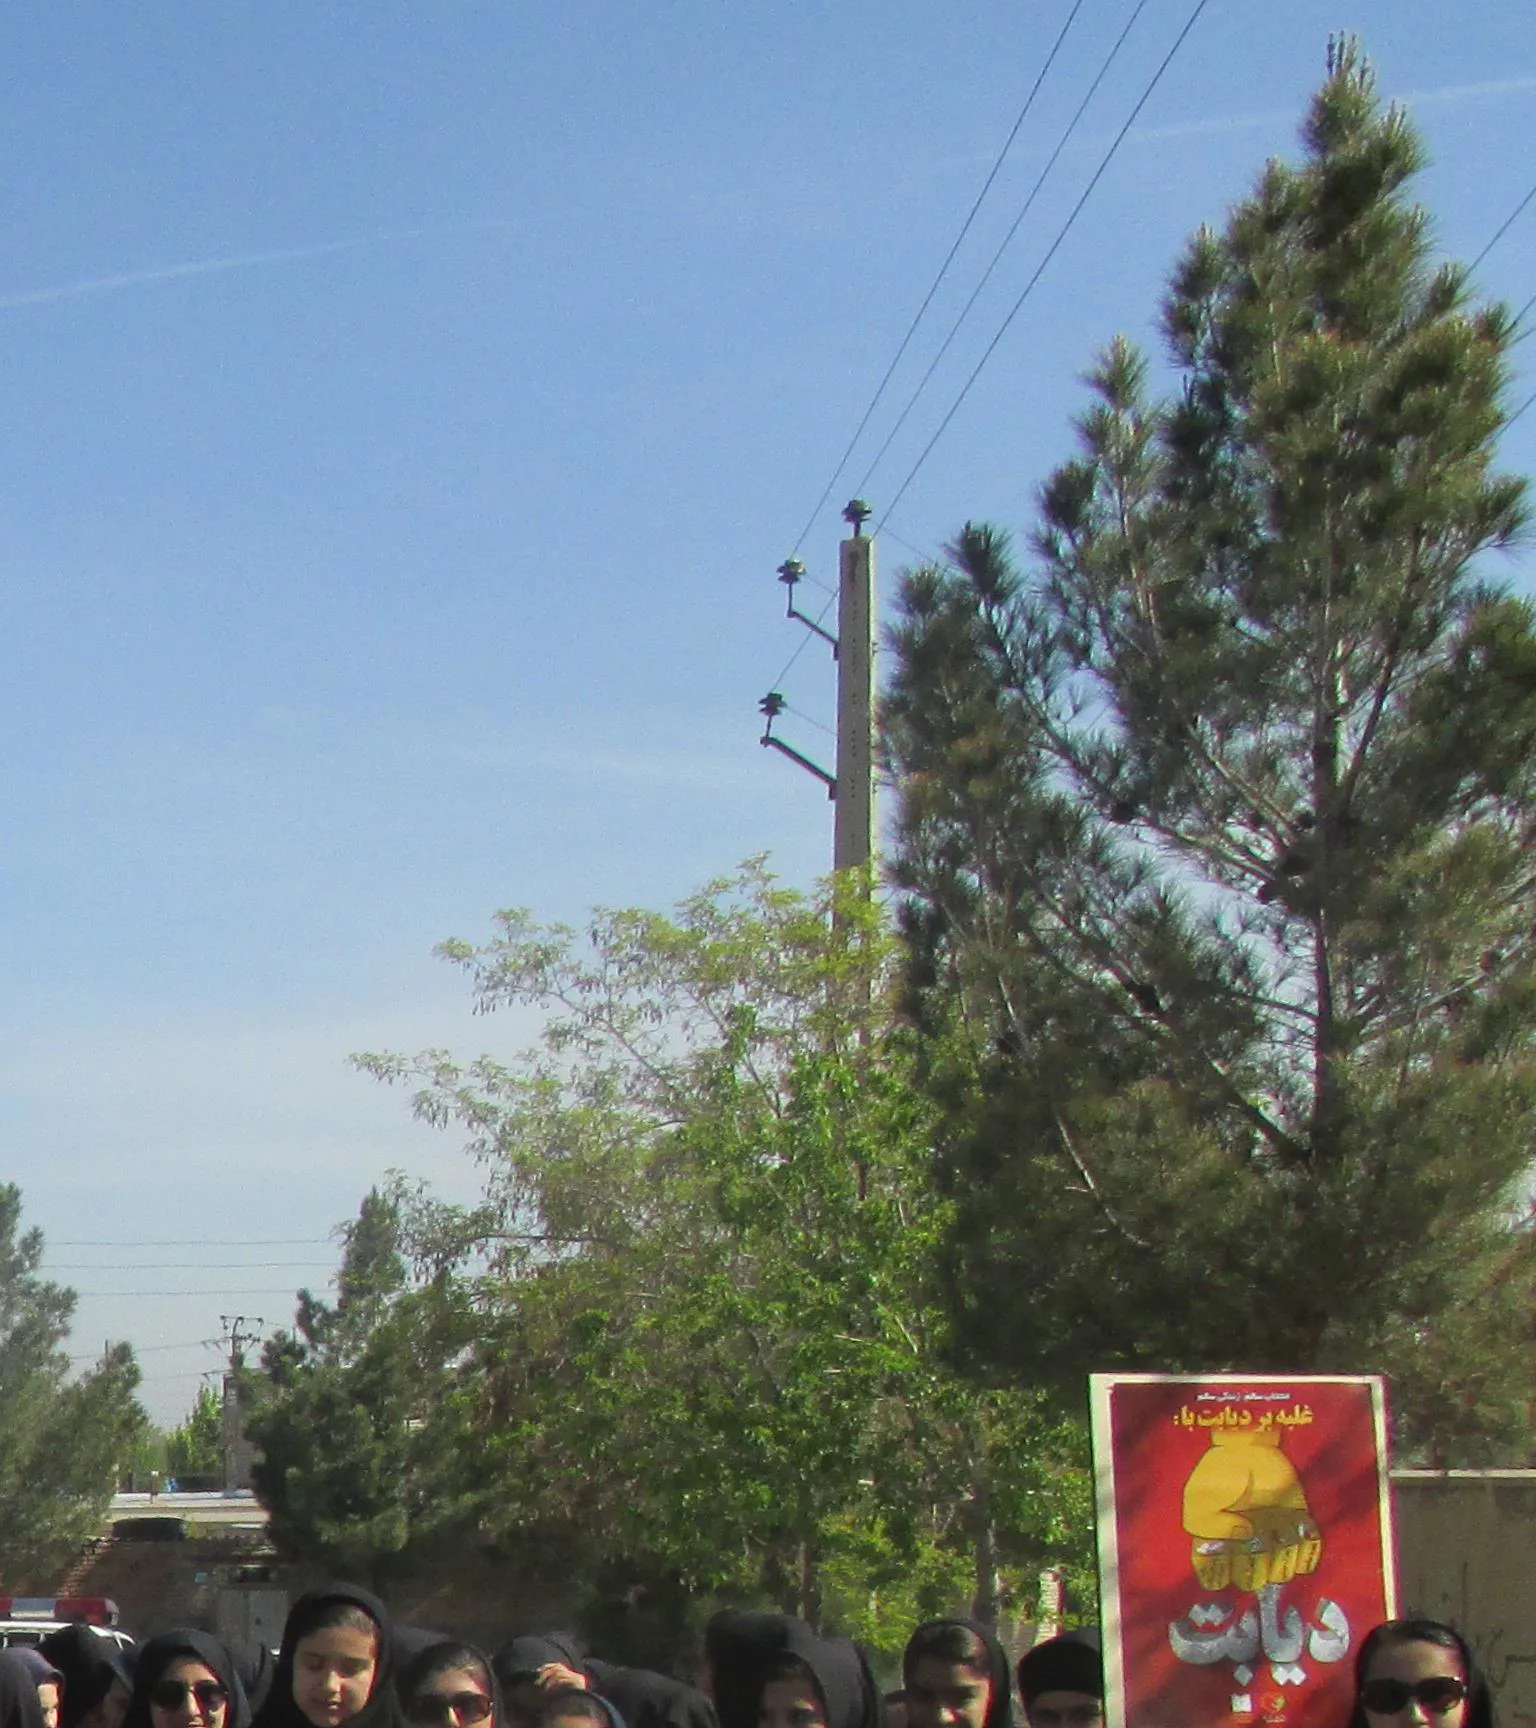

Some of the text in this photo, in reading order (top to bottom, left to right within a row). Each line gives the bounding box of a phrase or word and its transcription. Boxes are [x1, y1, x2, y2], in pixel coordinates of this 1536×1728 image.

[1196, 1405, 1252, 1431] دیابت
[1254, 1411, 1273, 1432] بر
[1275, 1404, 1313, 1431] غلبه
[1168, 1583, 1352, 1687] دیابت
